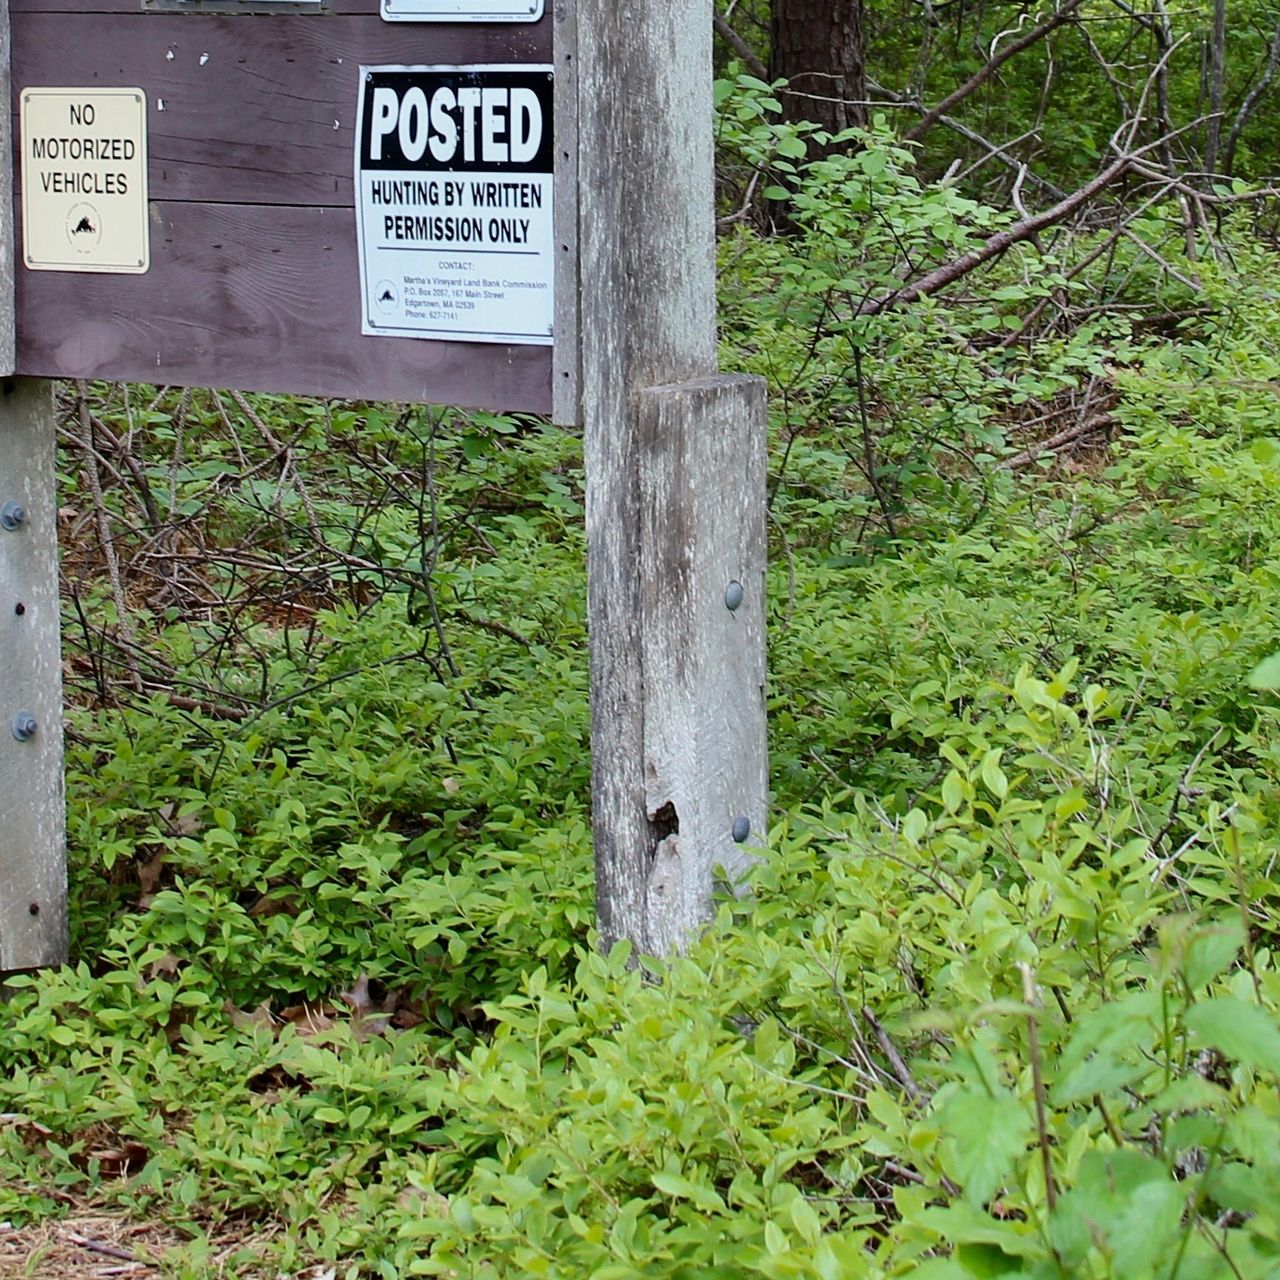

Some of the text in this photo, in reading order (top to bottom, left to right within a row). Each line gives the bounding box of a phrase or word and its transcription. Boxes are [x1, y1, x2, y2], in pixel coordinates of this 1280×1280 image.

[70, 104, 96, 126] NO
[369, 86, 543, 163] POSTED
[32, 137, 135, 160] MOTORIZED
[40, 172, 128, 195] VEHICLES
[371, 180, 542, 208] HUNTING BY WRITTEN
[384, 215, 530, 244] PERMISSION ONLY
[439, 261, 476, 271] CONTACT:
[403, 275, 547, 290] Martha's Vineyard Land Bank Commission
[404, 287, 417, 297] P.O.
[419, 288, 431, 297] Box
[465, 290, 481, 299] Main
[483, 291, 506, 300] Street
[405, 298, 441, 310] Edgartown,
[443, 300, 454, 309] MA
[405, 309, 429, 319] Phone:
